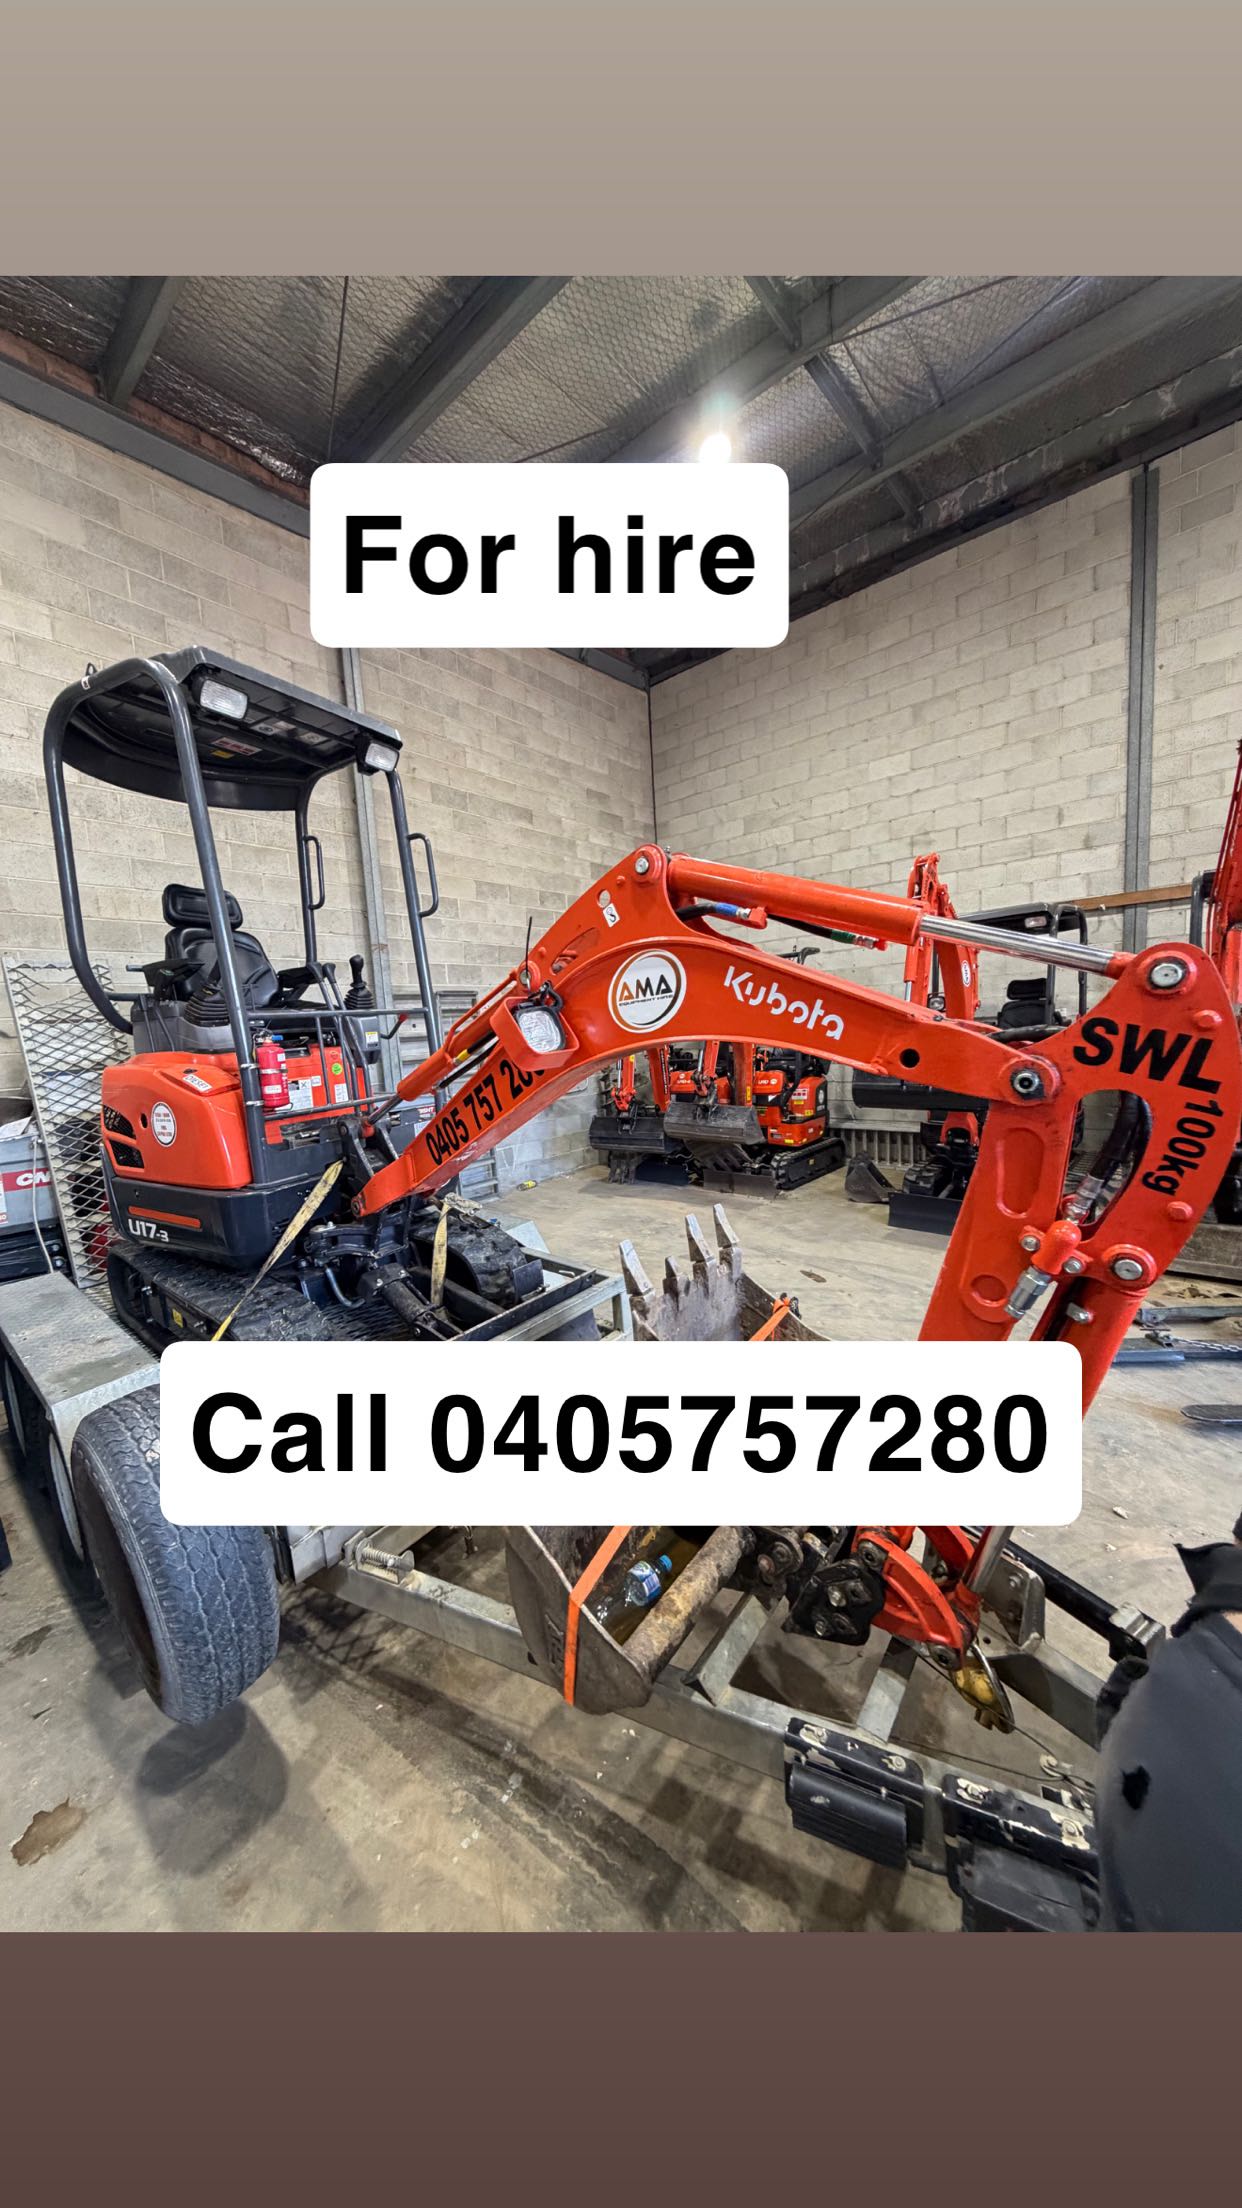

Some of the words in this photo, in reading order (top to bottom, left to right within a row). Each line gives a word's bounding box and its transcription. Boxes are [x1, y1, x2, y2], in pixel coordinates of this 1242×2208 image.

[618, 973, 673, 1002] AMA
[723, 965, 845, 1041] Kubota
[1073, 1017, 1222, 1095] SWL
[425, 1107, 470, 1166] 0405
[463, 1072, 503, 1131] 757
[1141, 1100, 1224, 1196] 100kg
[127, 1218, 169, 1243] U17-3
